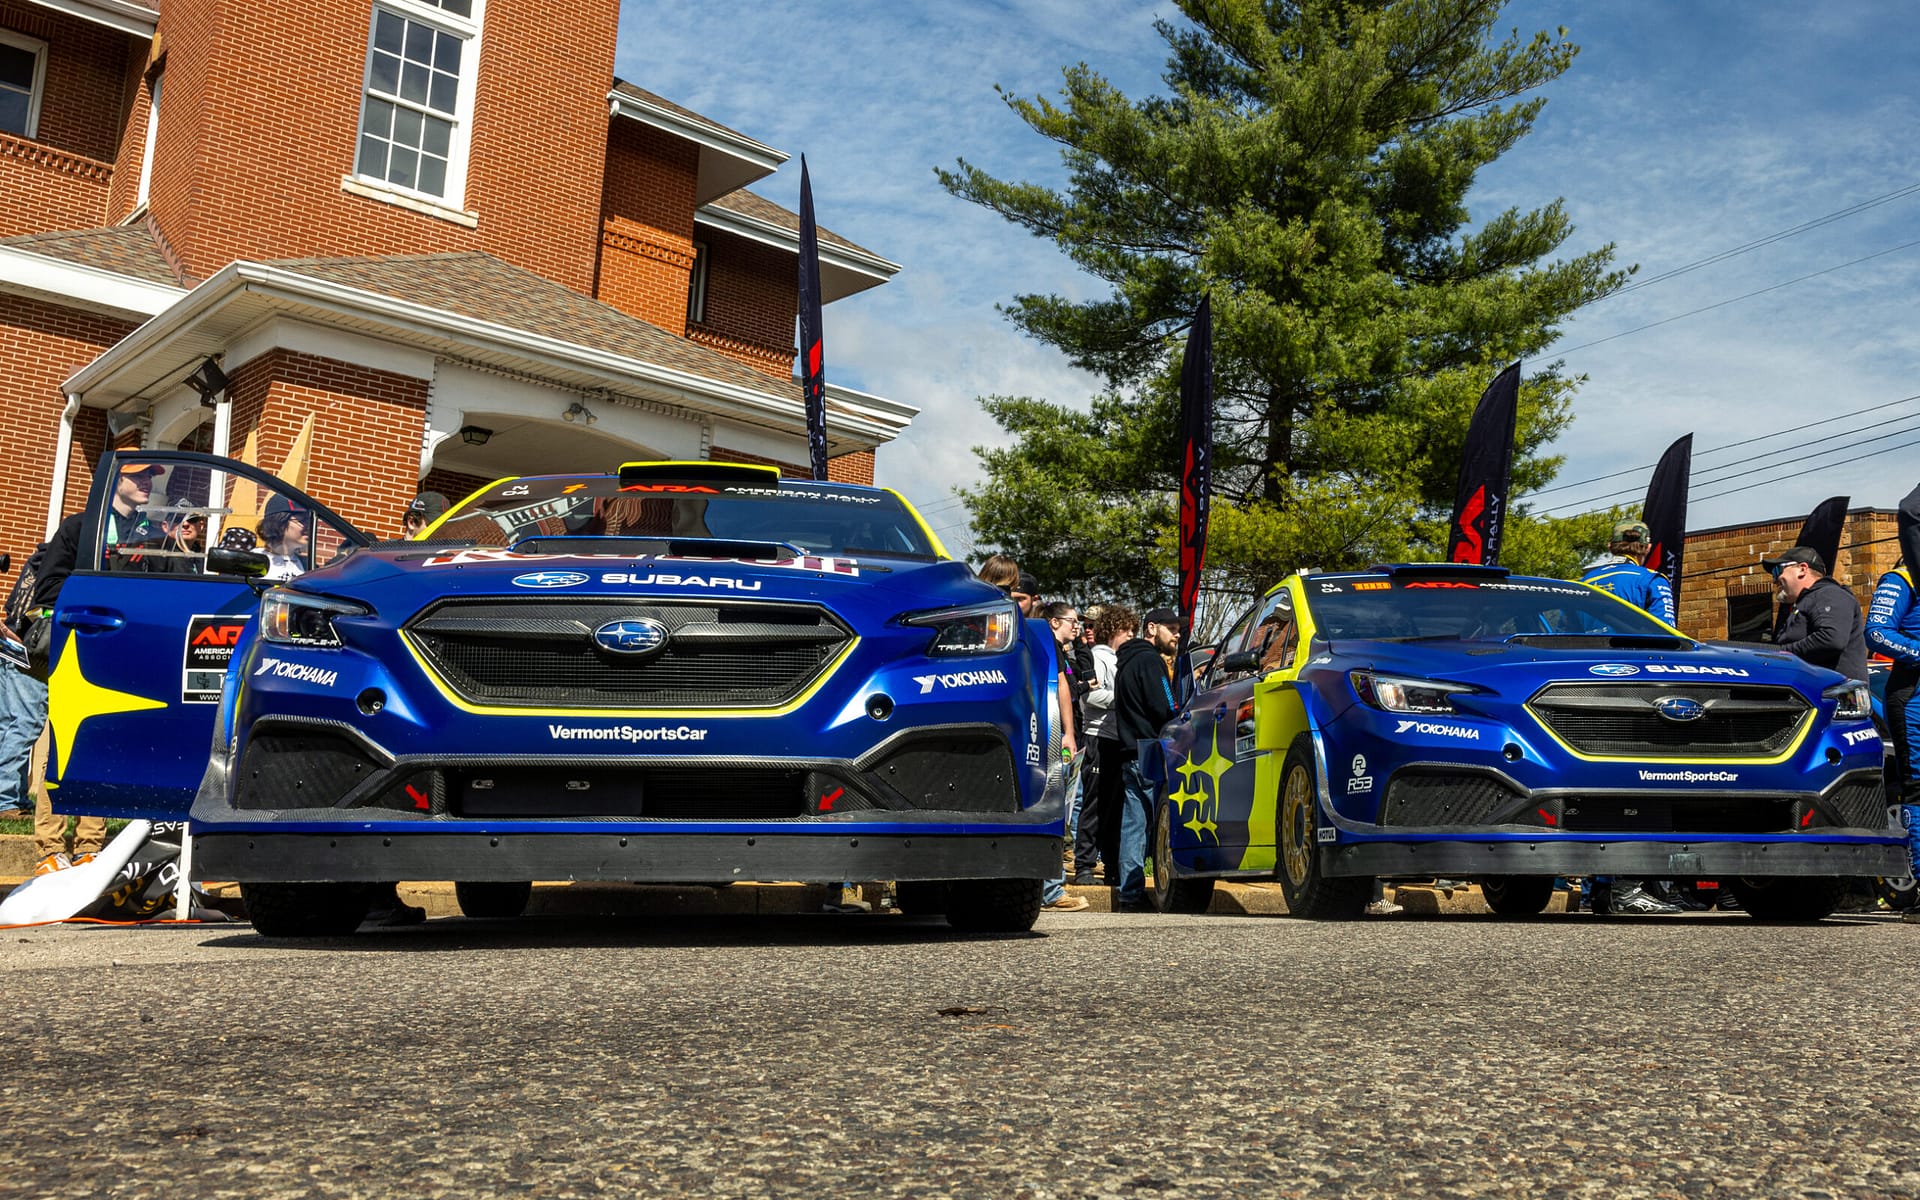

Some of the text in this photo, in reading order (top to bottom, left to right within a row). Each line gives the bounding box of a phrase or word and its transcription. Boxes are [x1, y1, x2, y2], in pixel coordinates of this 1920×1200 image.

[617, 485, 720, 493] ARA
[1487, 493, 1500, 551] RALLY
[601, 574, 761, 591] SUBARU
[1869, 614, 1888, 624] VSC
[272, 663, 337, 686] YOKOHAMA
[937, 670, 1007, 688] YOKOHAMA
[1645, 664, 1749, 677] SUBARU
[549, 725, 708, 743] VermontSportsCar
[1415, 723, 1479, 740] YOKOHAMA
[1347, 776, 1373, 790] R53
[1639, 770, 1738, 782] VermontSportsCar
